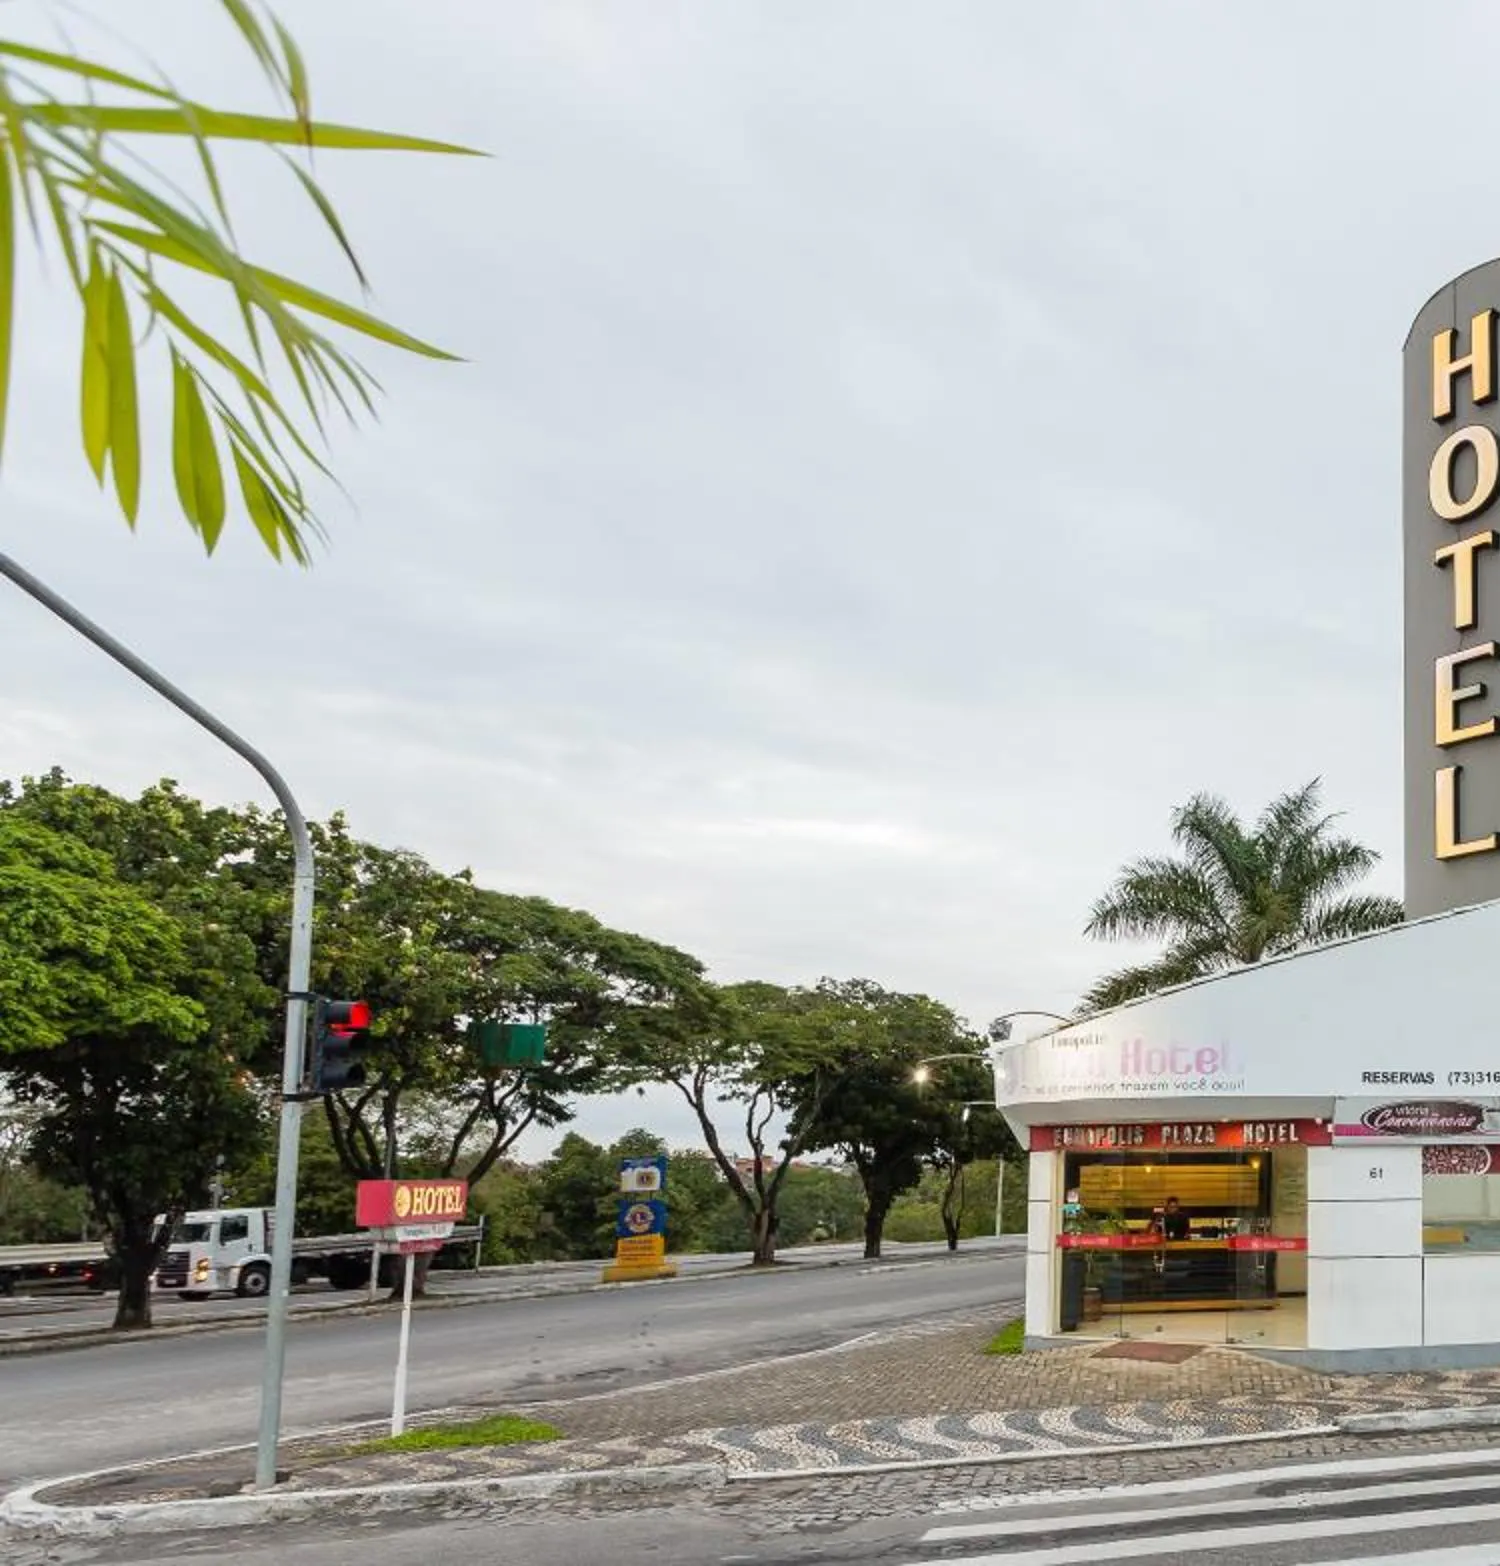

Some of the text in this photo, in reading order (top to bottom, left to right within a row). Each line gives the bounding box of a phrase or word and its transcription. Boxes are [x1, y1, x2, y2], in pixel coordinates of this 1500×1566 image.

[1362, 1071, 1435, 1085] RESERVAS
[1243, 1122, 1299, 1144] HOTEL
[412, 1186, 463, 1216] HOTEL
